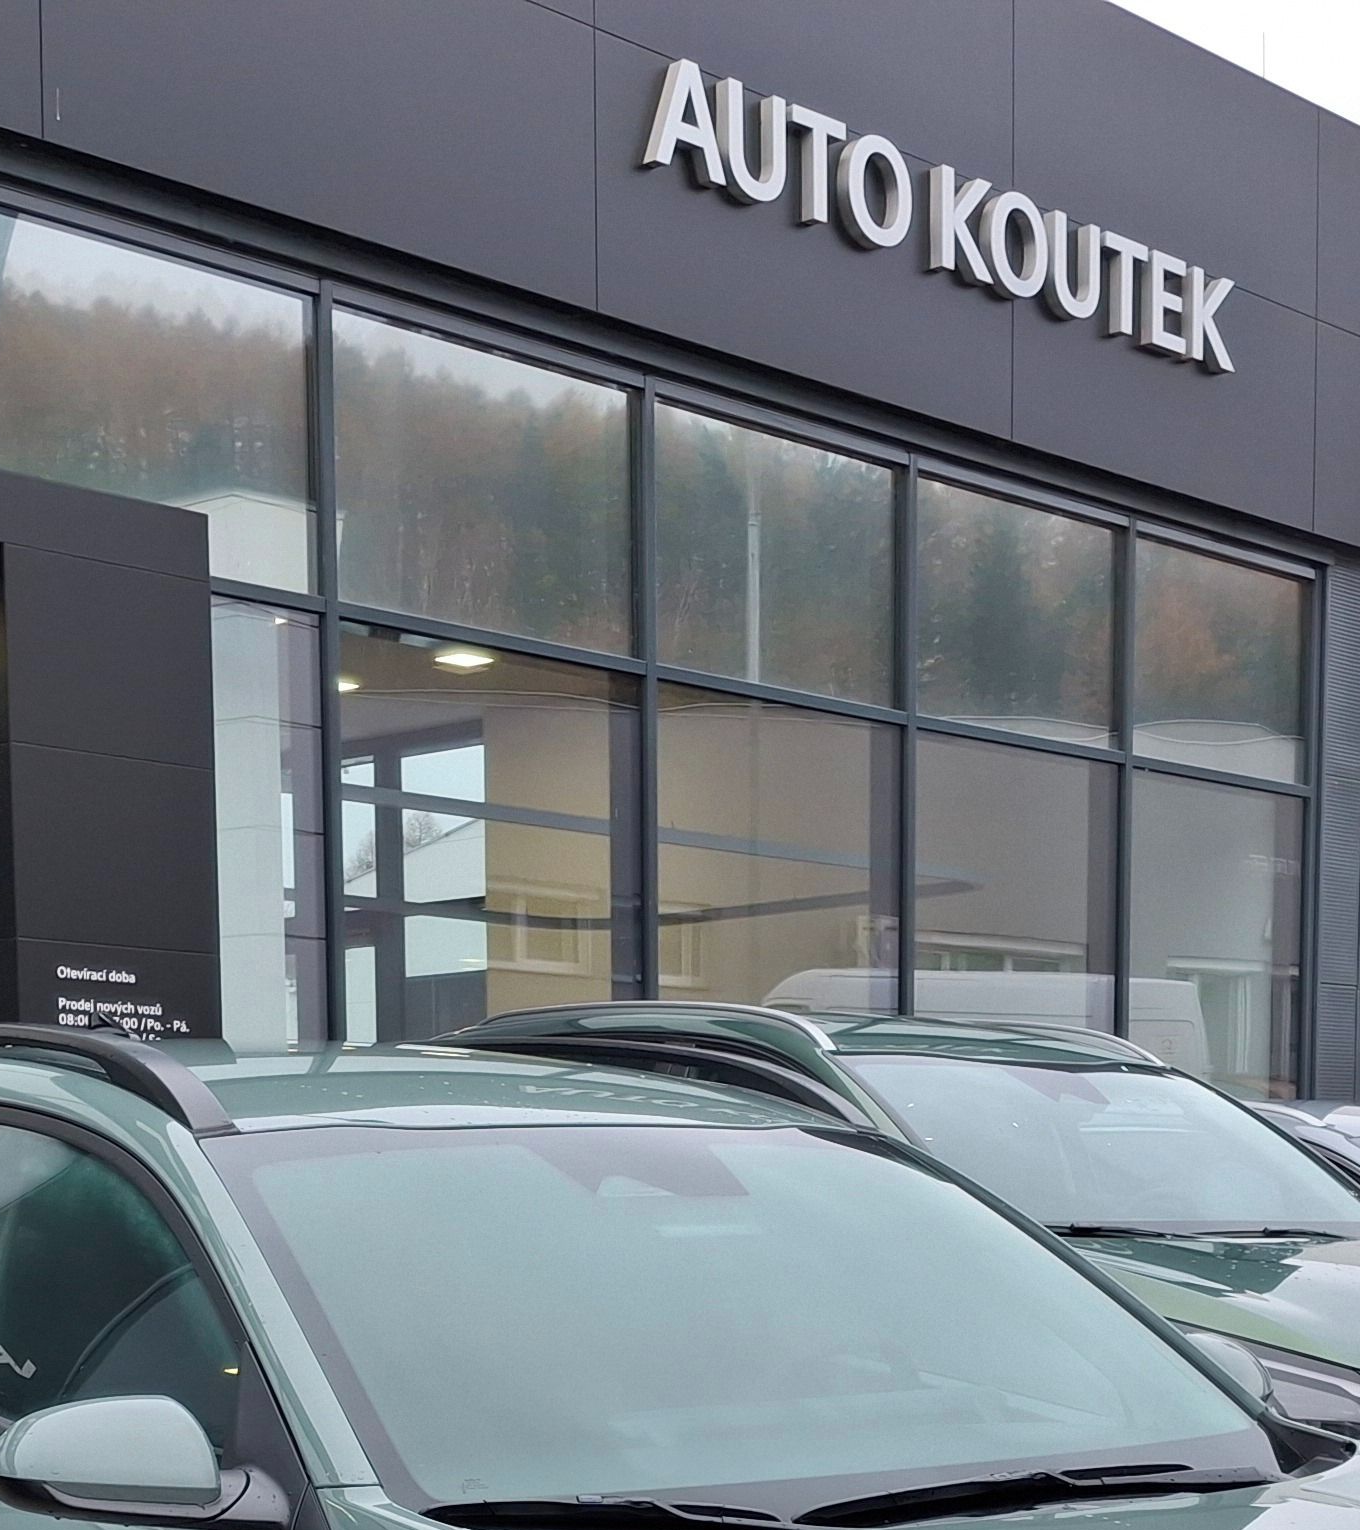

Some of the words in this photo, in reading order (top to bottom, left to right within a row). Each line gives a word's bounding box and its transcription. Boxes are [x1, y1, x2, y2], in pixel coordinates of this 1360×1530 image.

[642, 58, 912, 250] AUTO
[928, 164, 1236, 373] KOUTEK
[57, 966, 107, 981] Otevírací
[109, 971, 136, 983] doba
[58, 997, 93, 1012] Prodej
[96, 1002, 134, 1016] nových
[137, 1003, 162, 1015] vozů
[147, 1018, 164, 1031] Po.
[173, 1020, 190, 1032] Pá.
